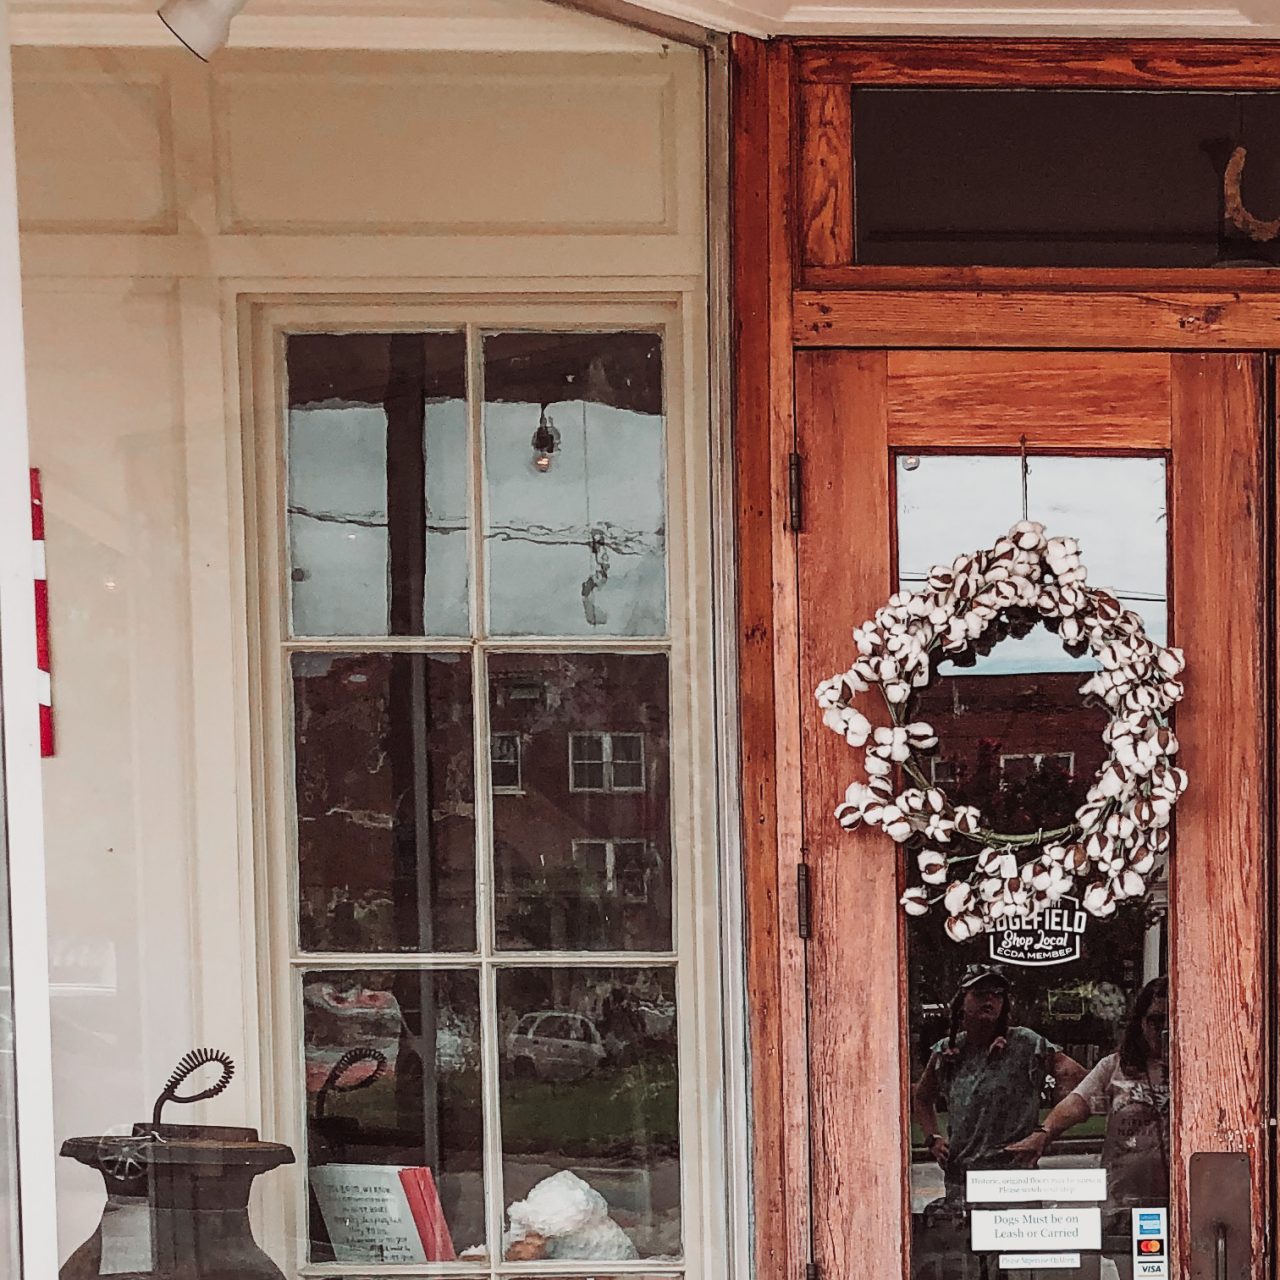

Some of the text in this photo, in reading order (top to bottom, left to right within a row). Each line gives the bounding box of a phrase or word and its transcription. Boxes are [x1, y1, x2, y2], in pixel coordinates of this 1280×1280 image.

[1002, 929, 1068, 950] Shop Local
[997, 947, 1025, 959] ECDA
[994, 1213, 1079, 1226] Dogs Must be on
[994, 1228, 1025, 1239] Leash
[1040, 1227, 1080, 1239] Carried
[1142, 1265, 1162, 1273] VISA
